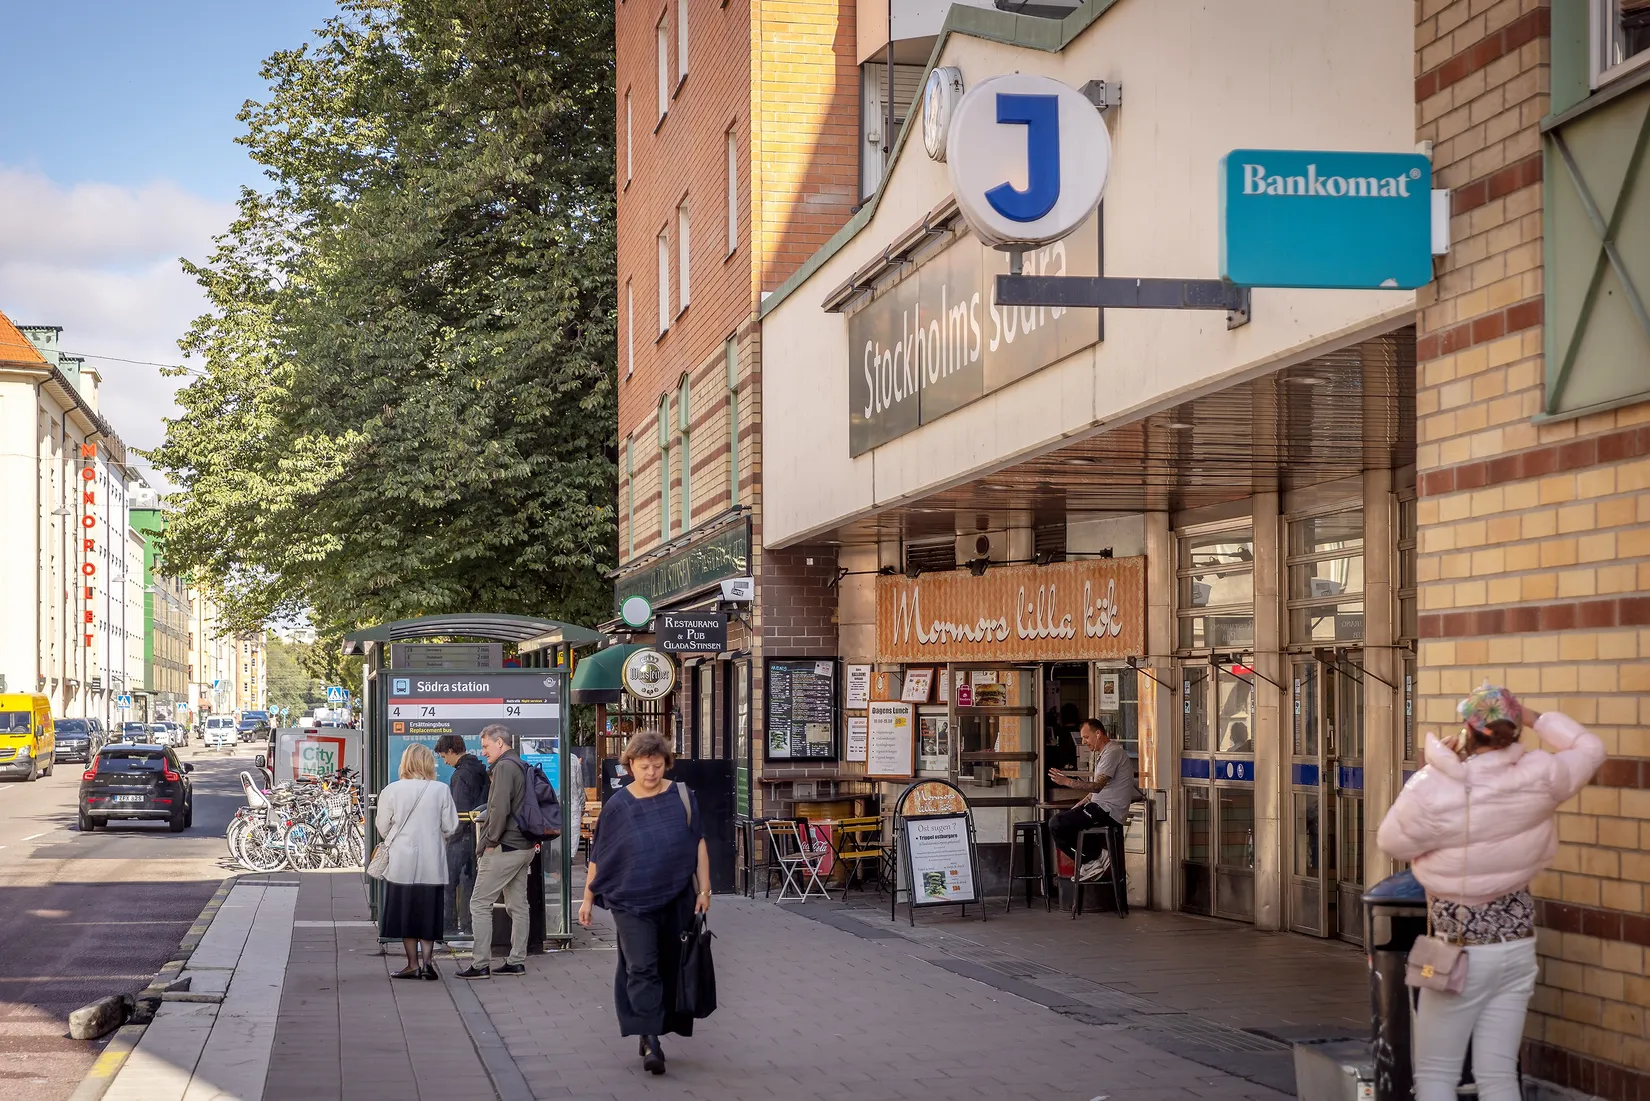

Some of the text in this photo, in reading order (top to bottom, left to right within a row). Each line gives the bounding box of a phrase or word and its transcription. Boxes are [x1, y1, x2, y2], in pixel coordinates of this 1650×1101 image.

[984, 92, 1061, 223] J
[864, 283, 981, 419] Stockholms
[81, 442, 97, 648] MONOPOLET
[893, 578, 1123, 645] Mormors lilla kök
[664, 616, 719, 628] RESTAURANG
[686, 628, 706, 640] PUB
[663, 640, 722, 650] GLADA STINSEN
[417, 681, 490, 692] Södra station
[393, 706, 521, 717] 4 74 94
[872, 707, 893, 715] Dagens
[302, 747, 334, 764] City
[917, 824, 930, 833] Ost
[931, 824, 951, 833] sugen
